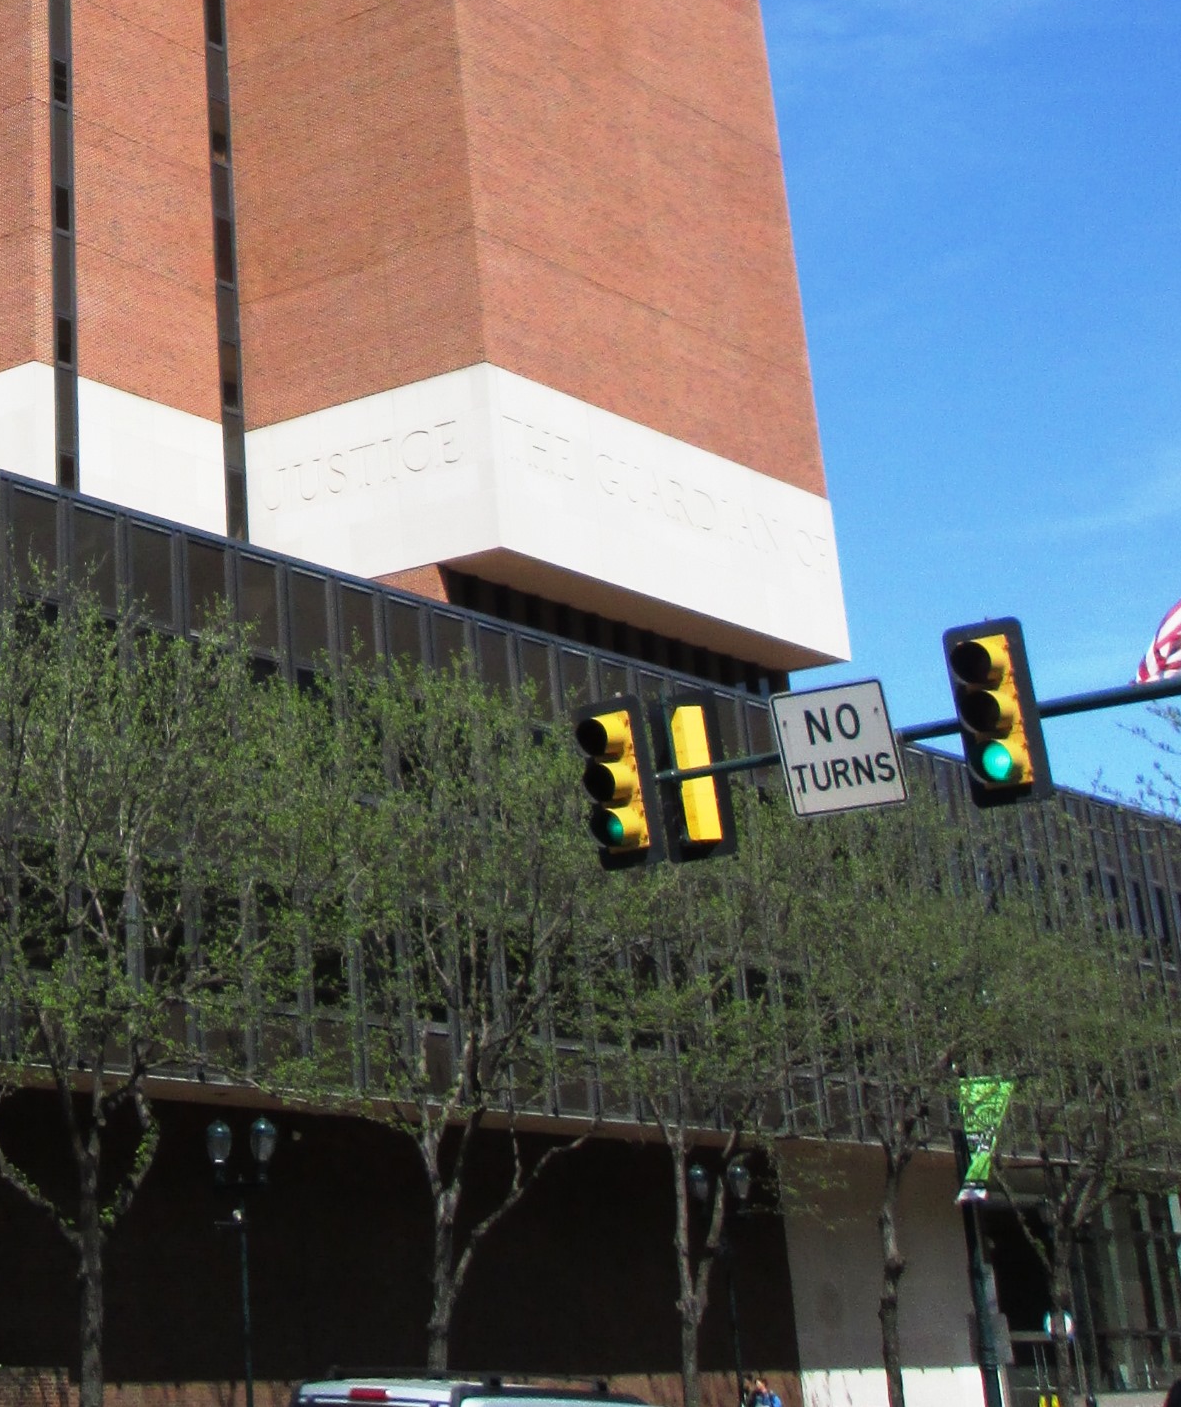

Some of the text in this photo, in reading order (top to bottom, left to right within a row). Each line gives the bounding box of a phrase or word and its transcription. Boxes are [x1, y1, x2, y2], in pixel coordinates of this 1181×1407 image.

[266, 420, 464, 511] JUSTICE
[502, 414, 575, 482] THE
[804, 703, 860, 745] NO
[791, 752, 895, 794] TURNS
